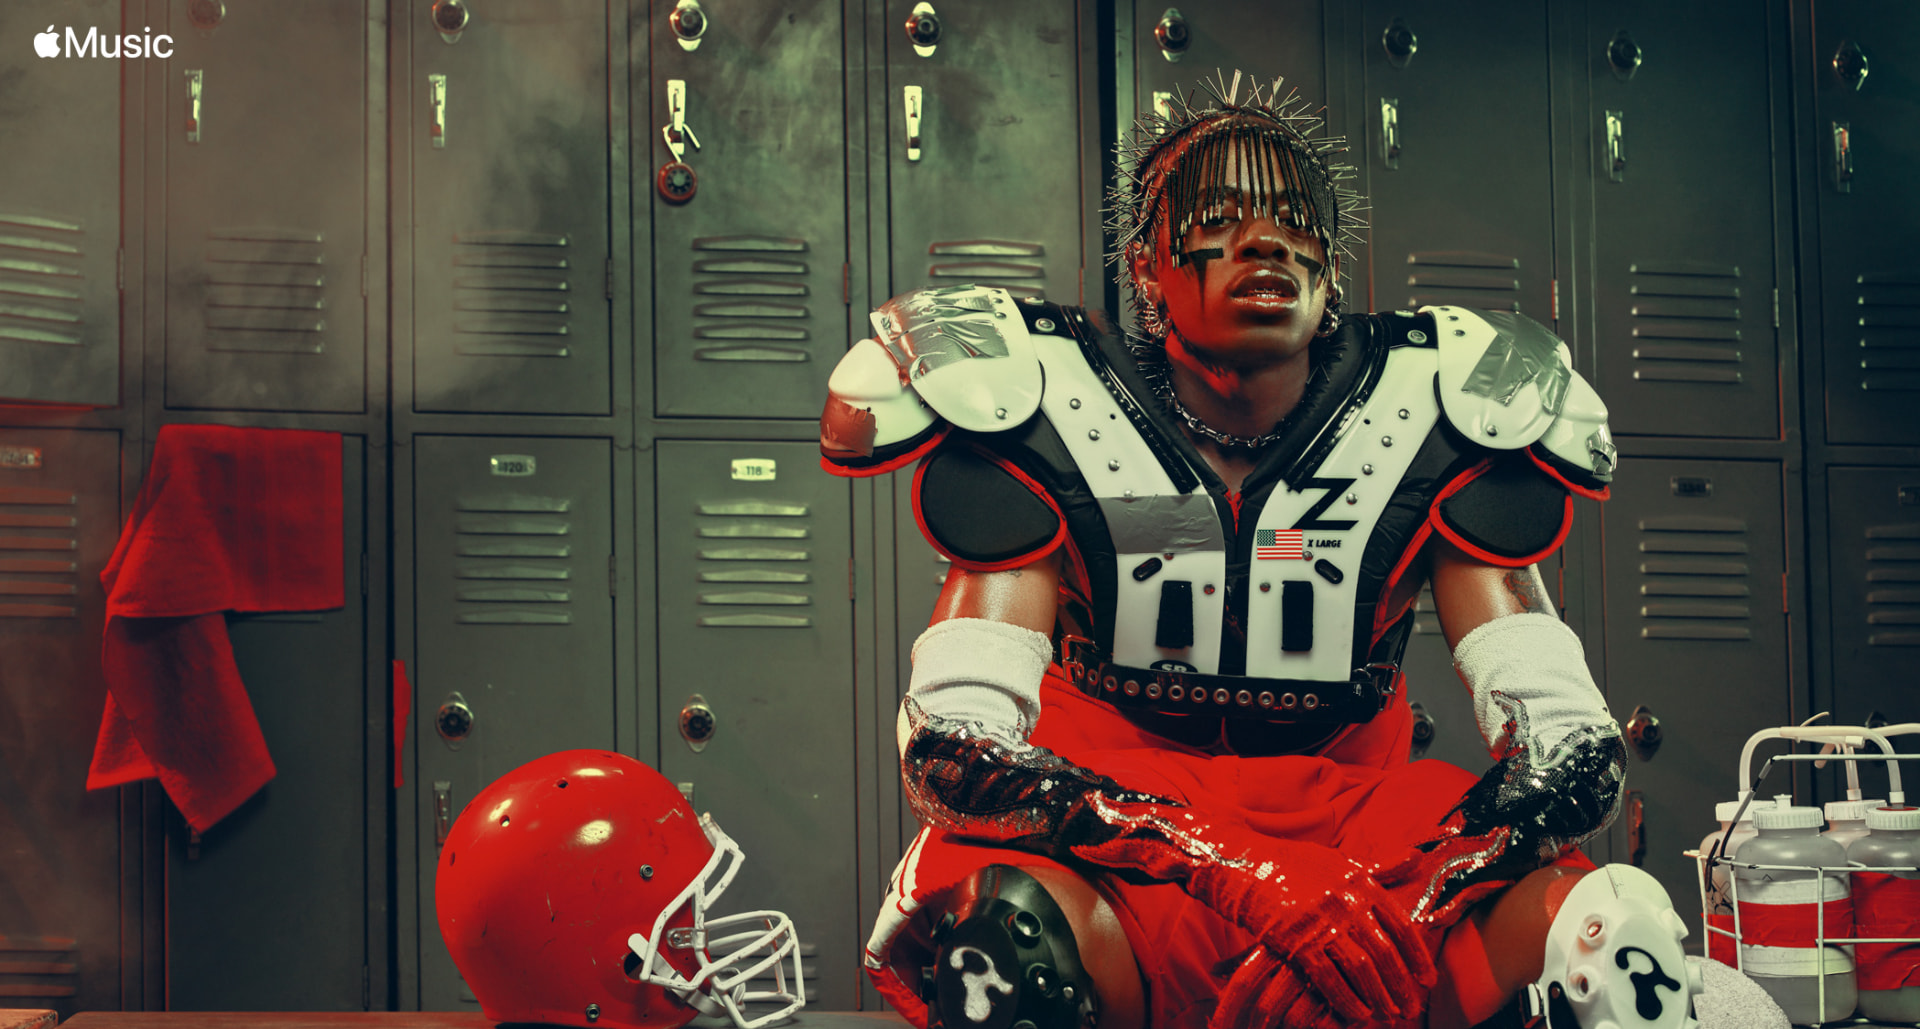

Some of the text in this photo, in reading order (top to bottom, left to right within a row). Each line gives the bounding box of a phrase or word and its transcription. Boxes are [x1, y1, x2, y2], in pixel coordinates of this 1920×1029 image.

[746, 465, 762, 476] 118
[1307, 539, 1342, 548] X LARGE
